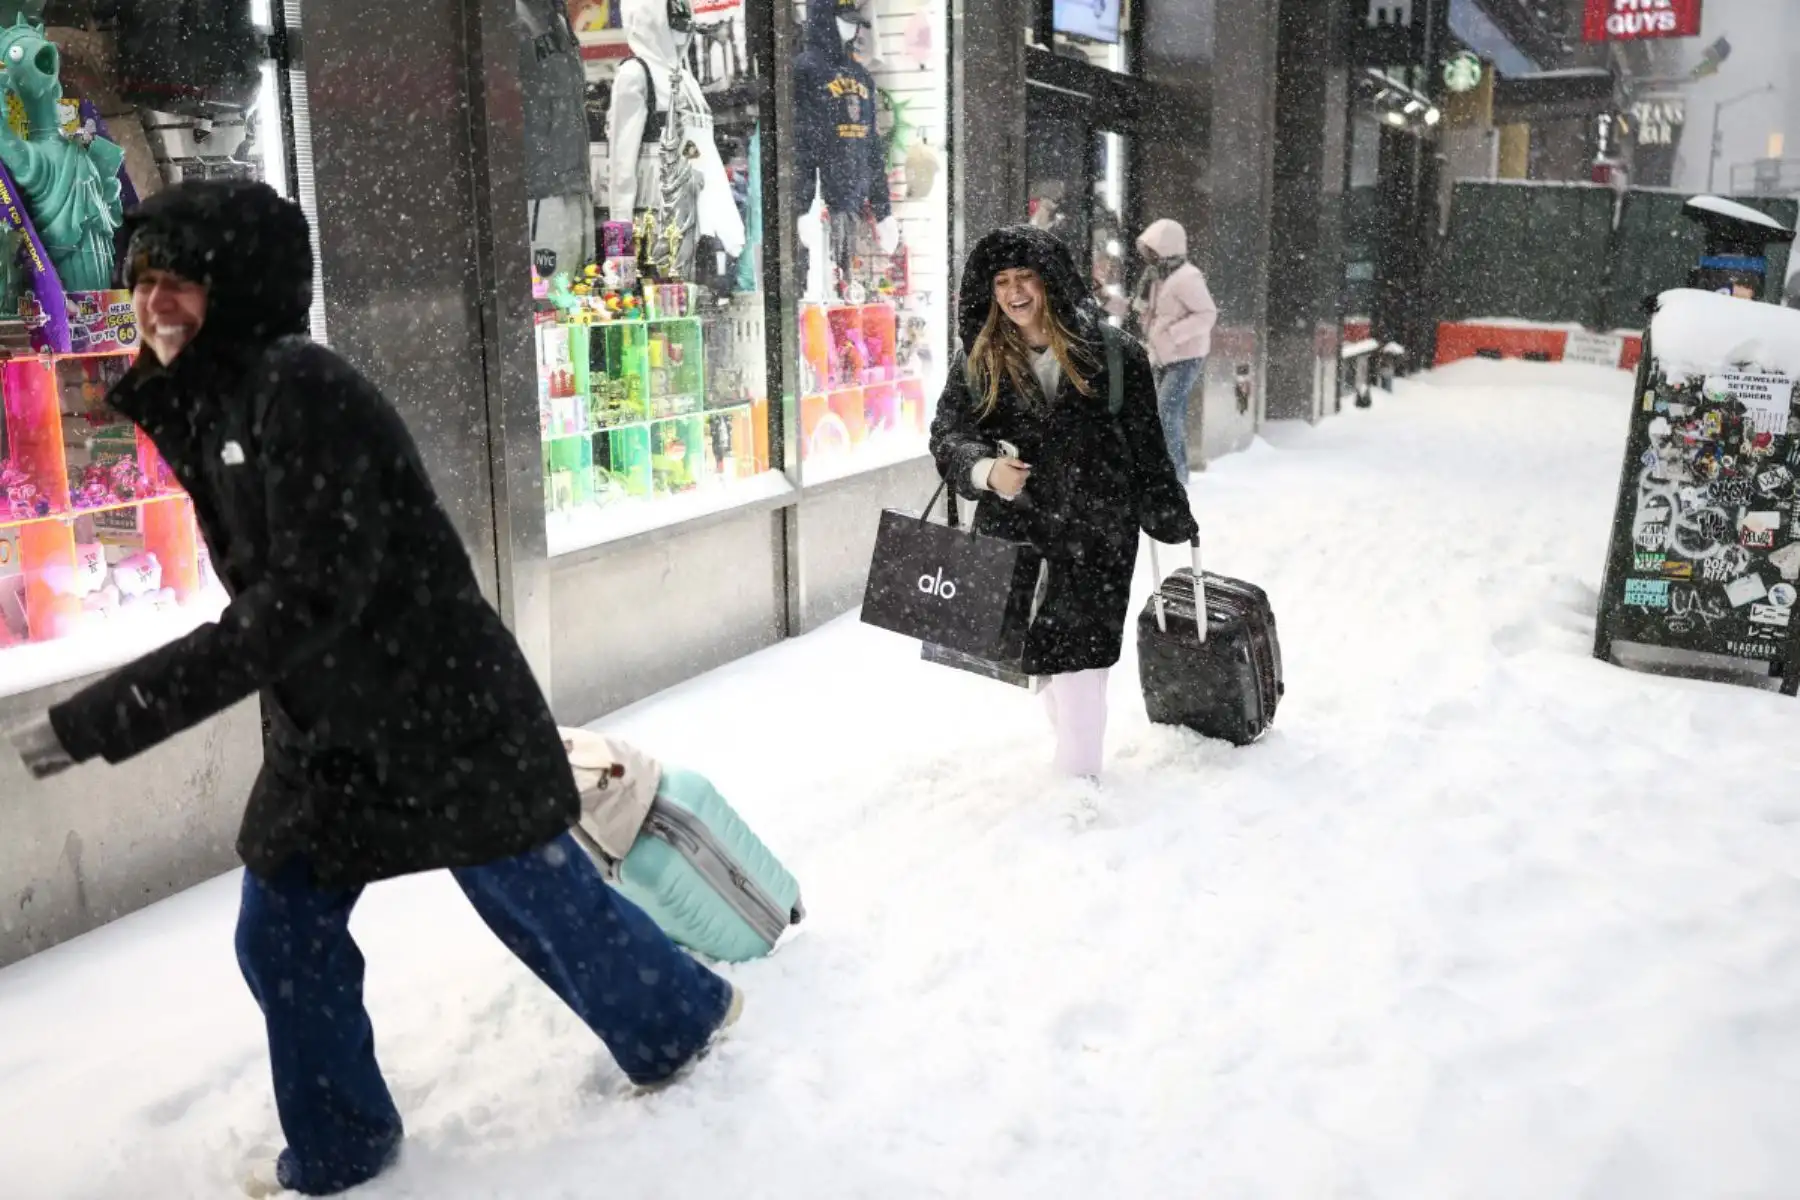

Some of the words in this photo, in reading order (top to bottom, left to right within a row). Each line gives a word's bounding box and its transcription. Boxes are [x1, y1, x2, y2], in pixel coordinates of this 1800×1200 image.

[1605, 9, 1676, 34] GUYS
[1638, 121, 1672, 145] BAR
[8, 206, 22, 225] FOR
[536, 254, 556, 268] NYC
[119, 327, 136, 340] 60
[1727, 383, 1768, 392] SETTERS
[1742, 375, 1790, 385] JEWELERS
[1735, 392, 1773, 401] LISHERS
[1703, 567, 1728, 582] RITA
[918, 566, 956, 599] alo
[1727, 640, 1777, 656] BLACKBOX
